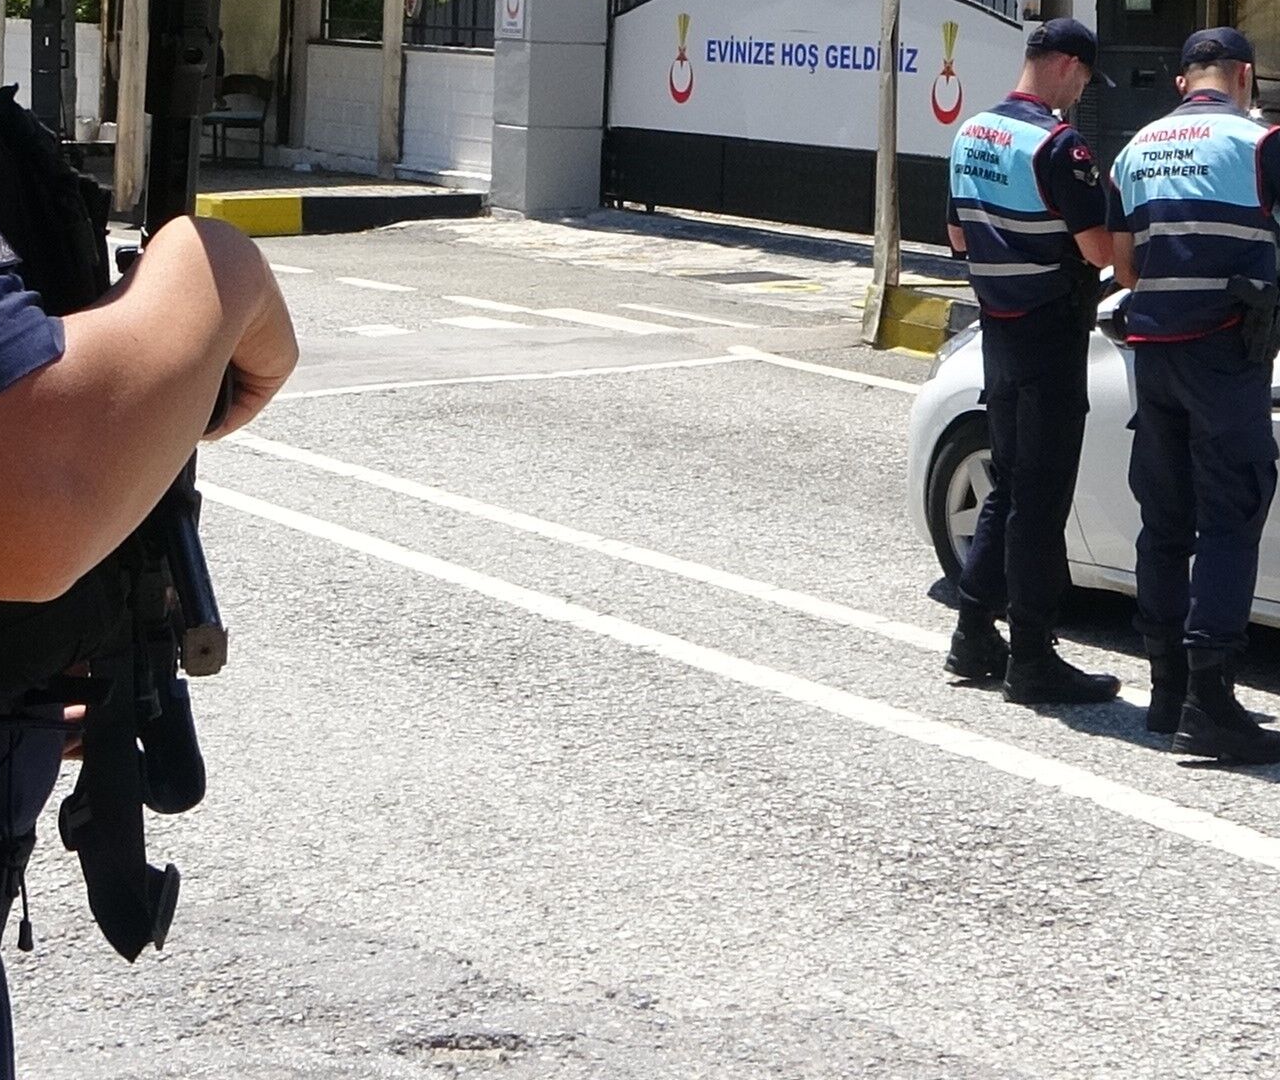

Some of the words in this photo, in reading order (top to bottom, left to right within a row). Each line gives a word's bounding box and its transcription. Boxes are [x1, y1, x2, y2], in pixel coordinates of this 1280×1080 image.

[706, 35, 775, 66] EVİNİZE
[781, 43, 819, 74] HOŞ
[825, 41, 919, 73] GELDİİZ
[1141, 148, 1195, 162] TOURISM
[954, 163, 1009, 186] GDARMERIE
[1130, 164, 1209, 182] GENDARMERIE
